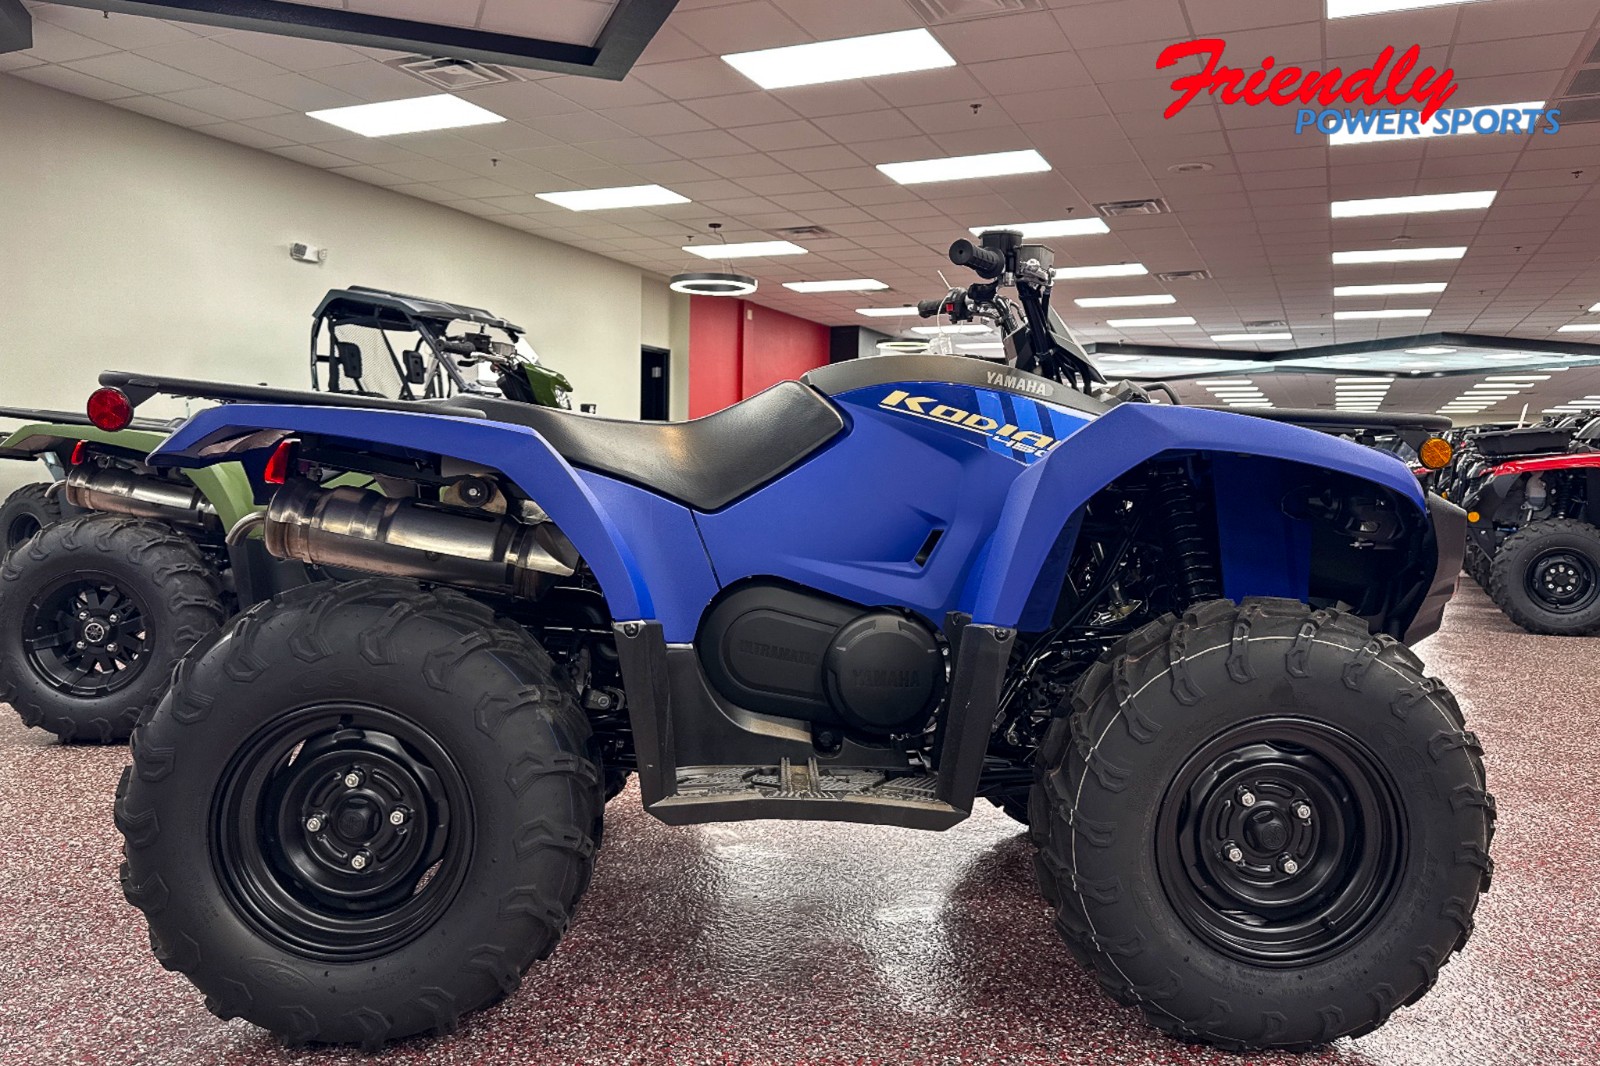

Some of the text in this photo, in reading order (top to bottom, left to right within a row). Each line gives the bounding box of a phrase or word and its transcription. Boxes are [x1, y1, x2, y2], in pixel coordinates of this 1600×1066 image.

[986, 371, 1047, 396] YAMAHA
[880, 390, 1061, 451] KODIA
[852, 668, 920, 688] YAMAHA
